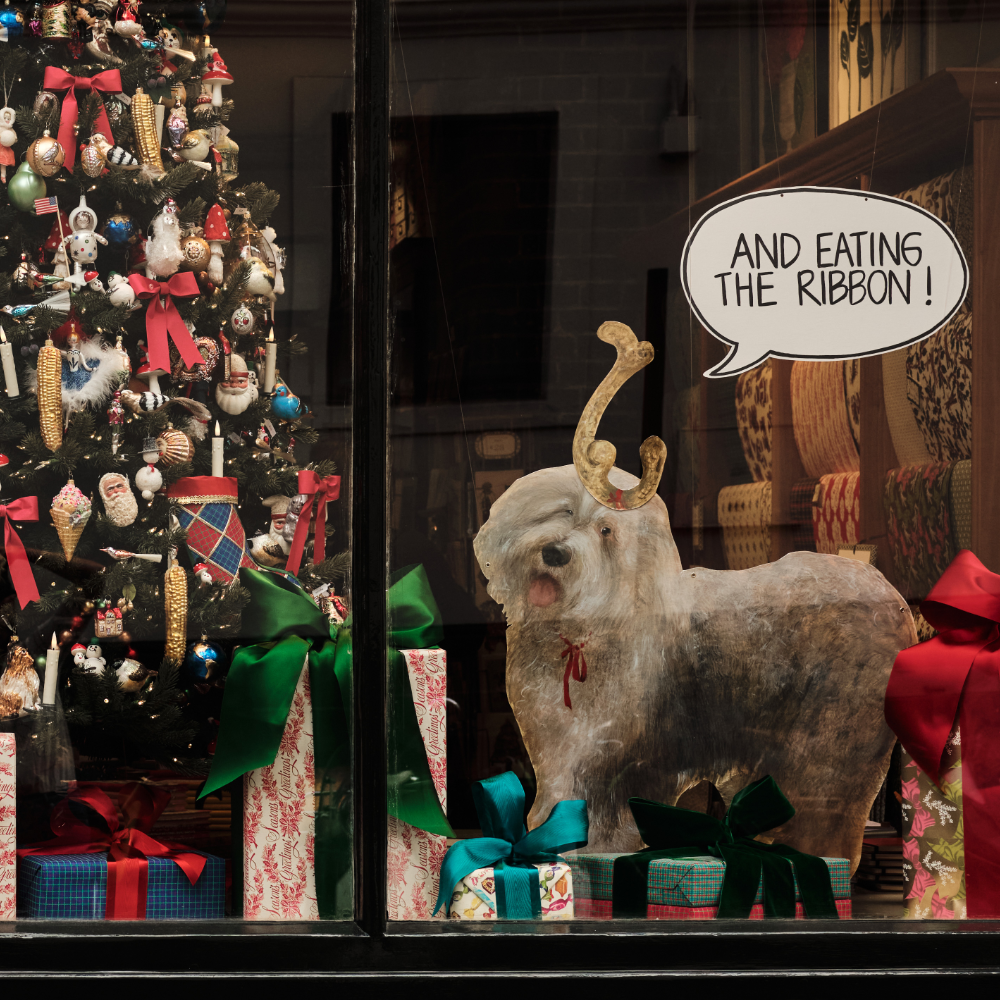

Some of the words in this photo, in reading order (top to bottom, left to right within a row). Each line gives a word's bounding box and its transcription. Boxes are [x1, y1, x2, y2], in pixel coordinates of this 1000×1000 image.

[730, 232, 802, 270] AND
[816, 230, 923, 268] EATING
[714, 271, 778, 307] THE
